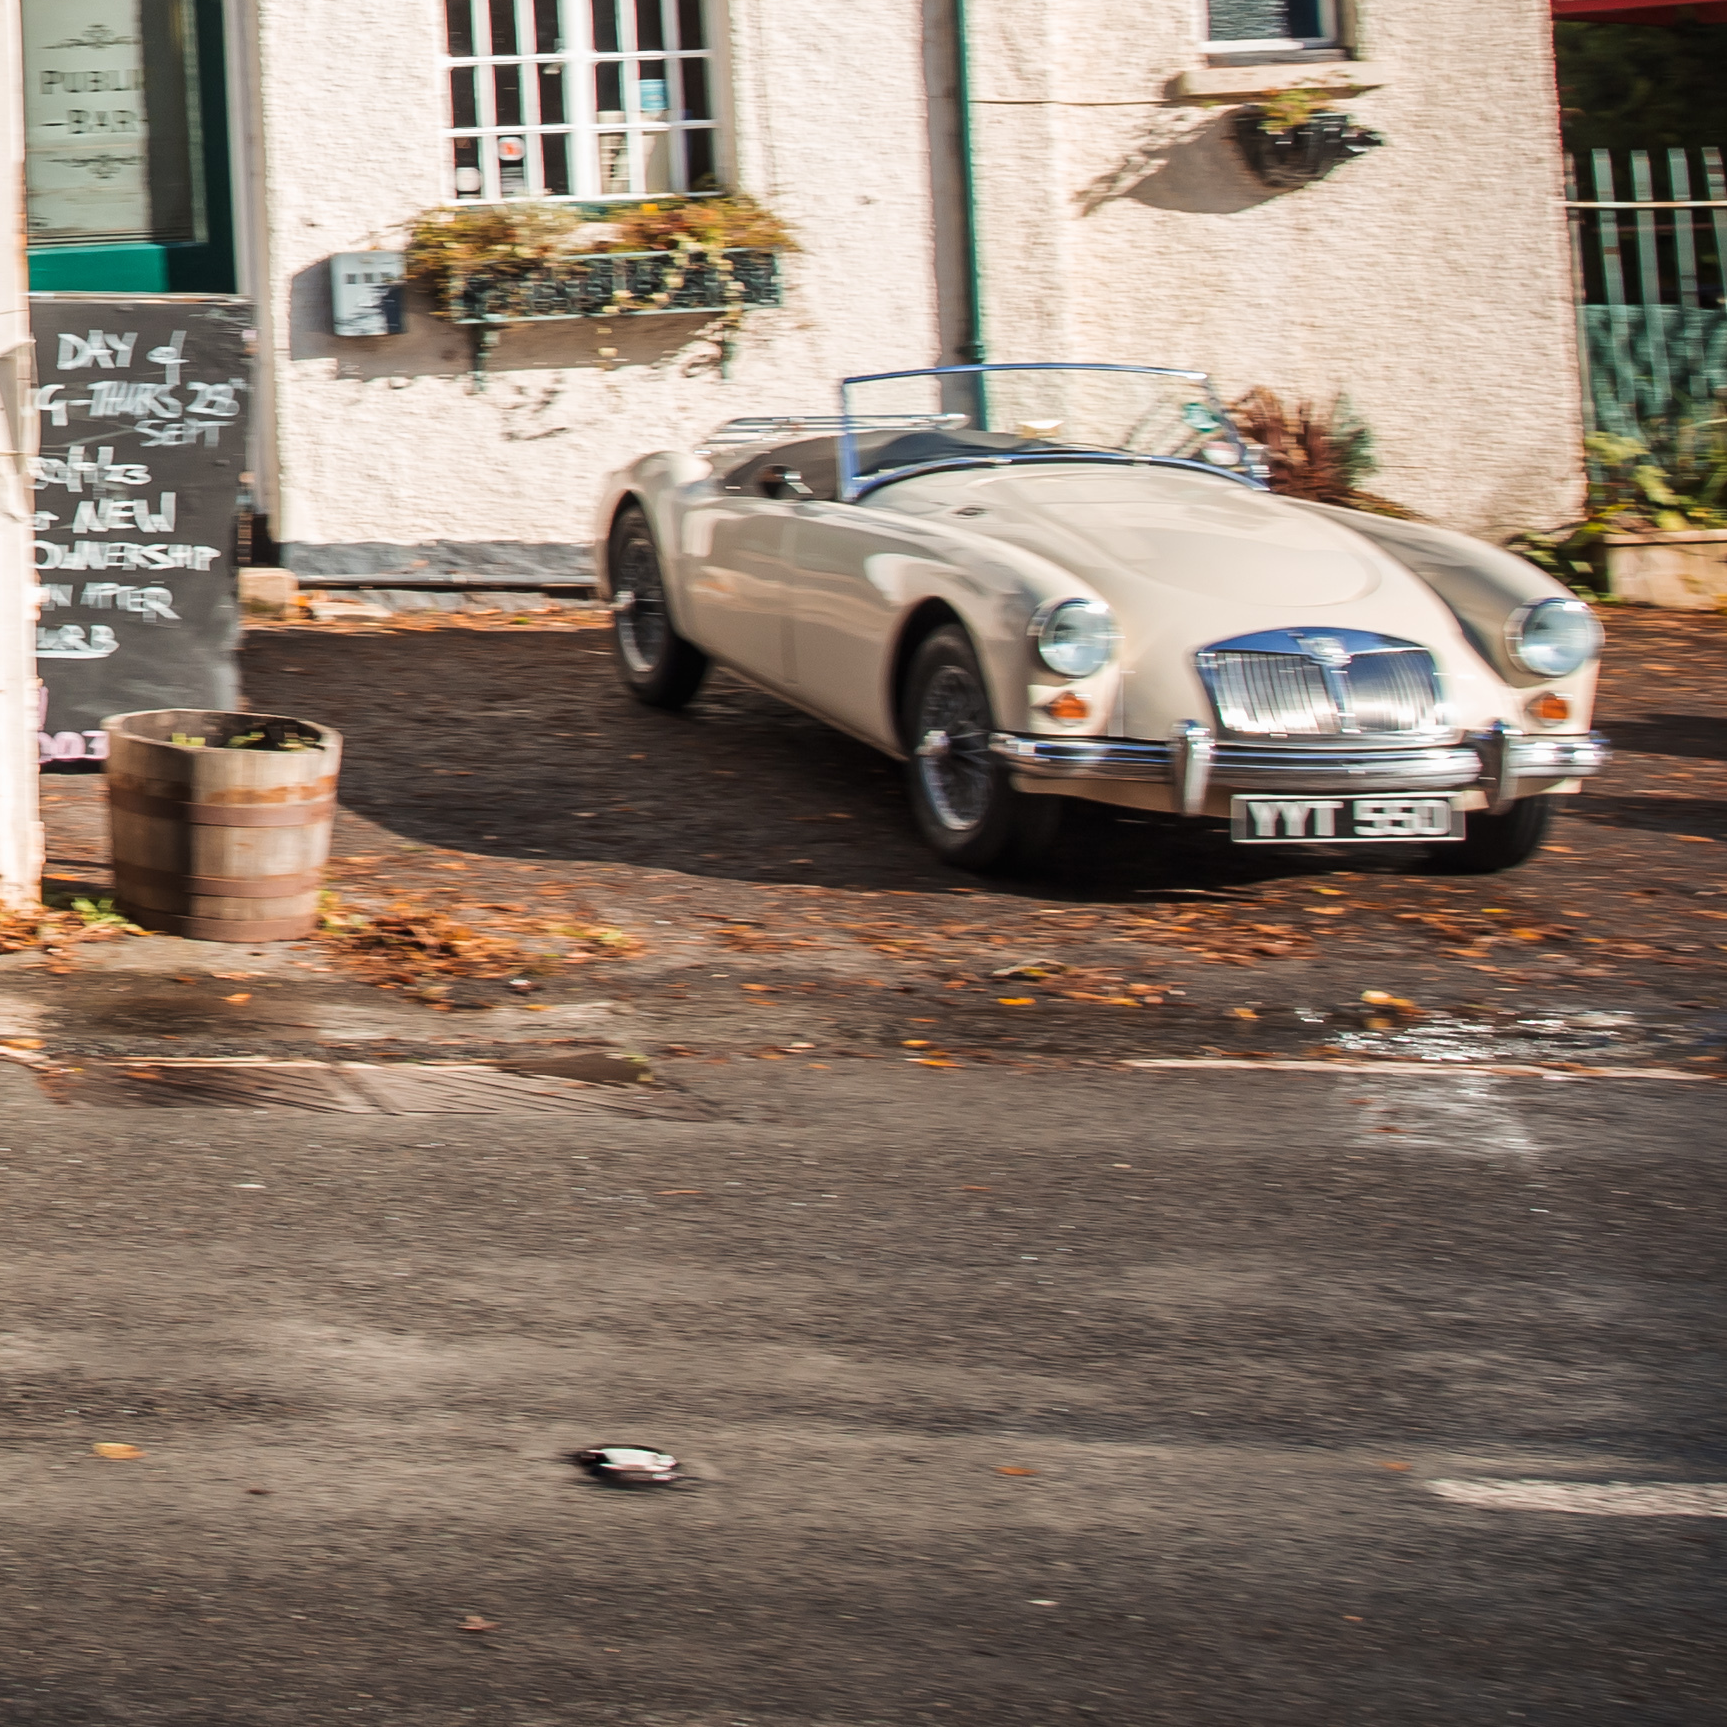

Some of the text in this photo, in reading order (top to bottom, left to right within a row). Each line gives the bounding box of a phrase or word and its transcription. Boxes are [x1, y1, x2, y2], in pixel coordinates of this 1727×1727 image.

[67, 109, 139, 135] BAR
[56, 329, 138, 370] DAY
[72, 491, 176, 534] NEW
[1247, 799, 1344, 837] YYT
